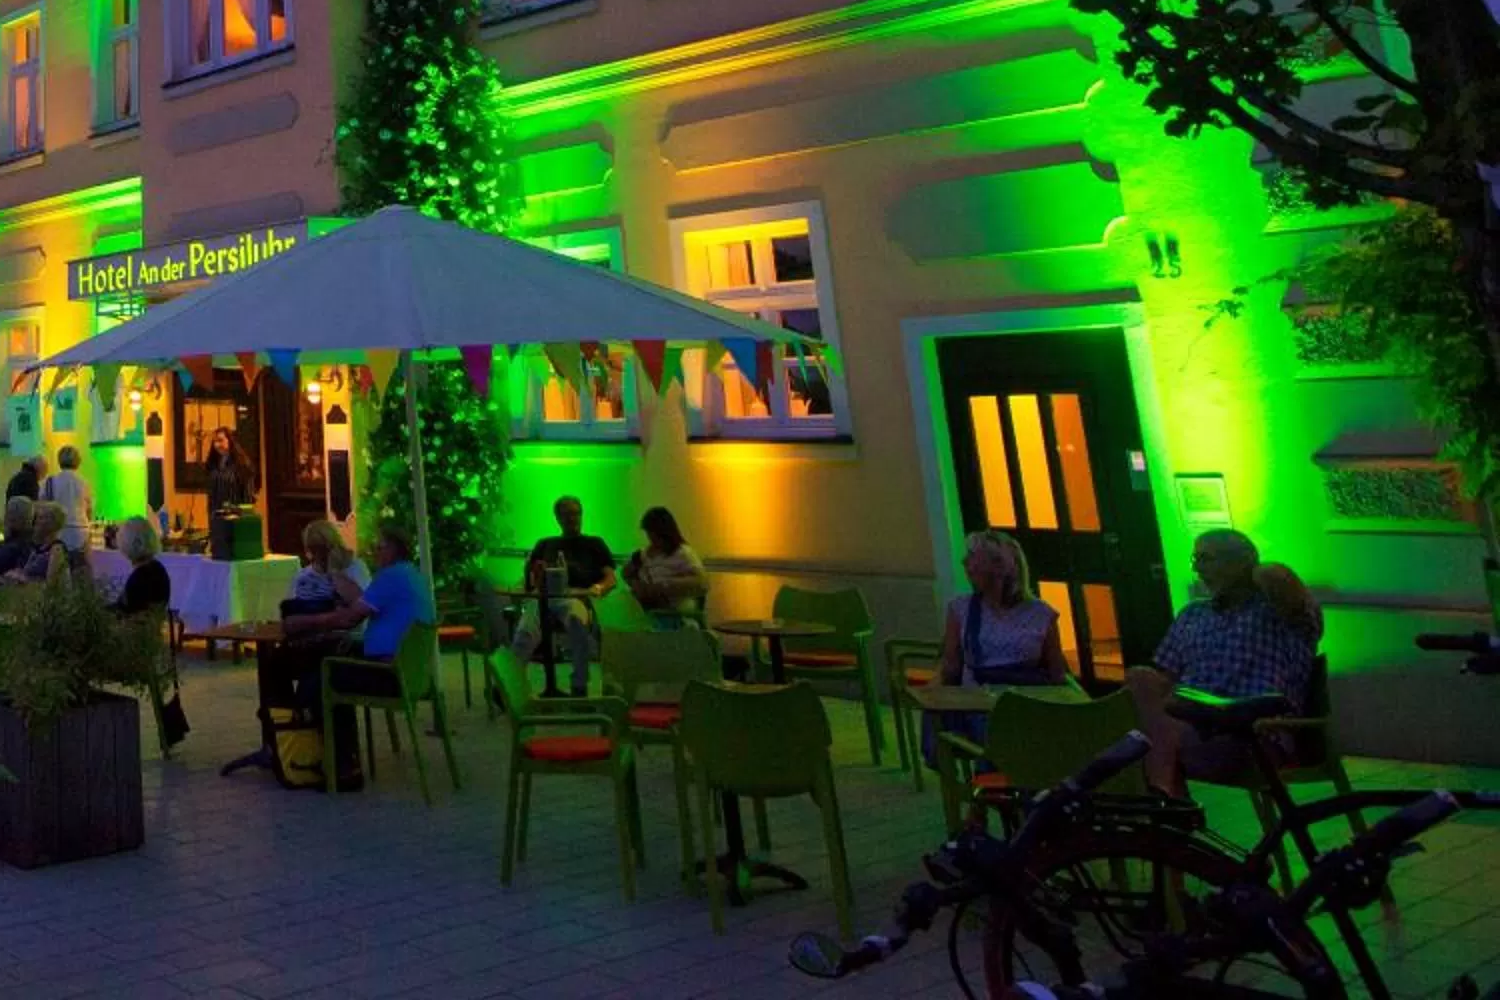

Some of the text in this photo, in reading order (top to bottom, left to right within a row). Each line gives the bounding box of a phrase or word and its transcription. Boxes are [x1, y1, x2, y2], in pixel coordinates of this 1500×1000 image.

[78, 256, 133, 296] Hotel
[137, 261, 159, 285] An
[160, 257, 186, 282] der
